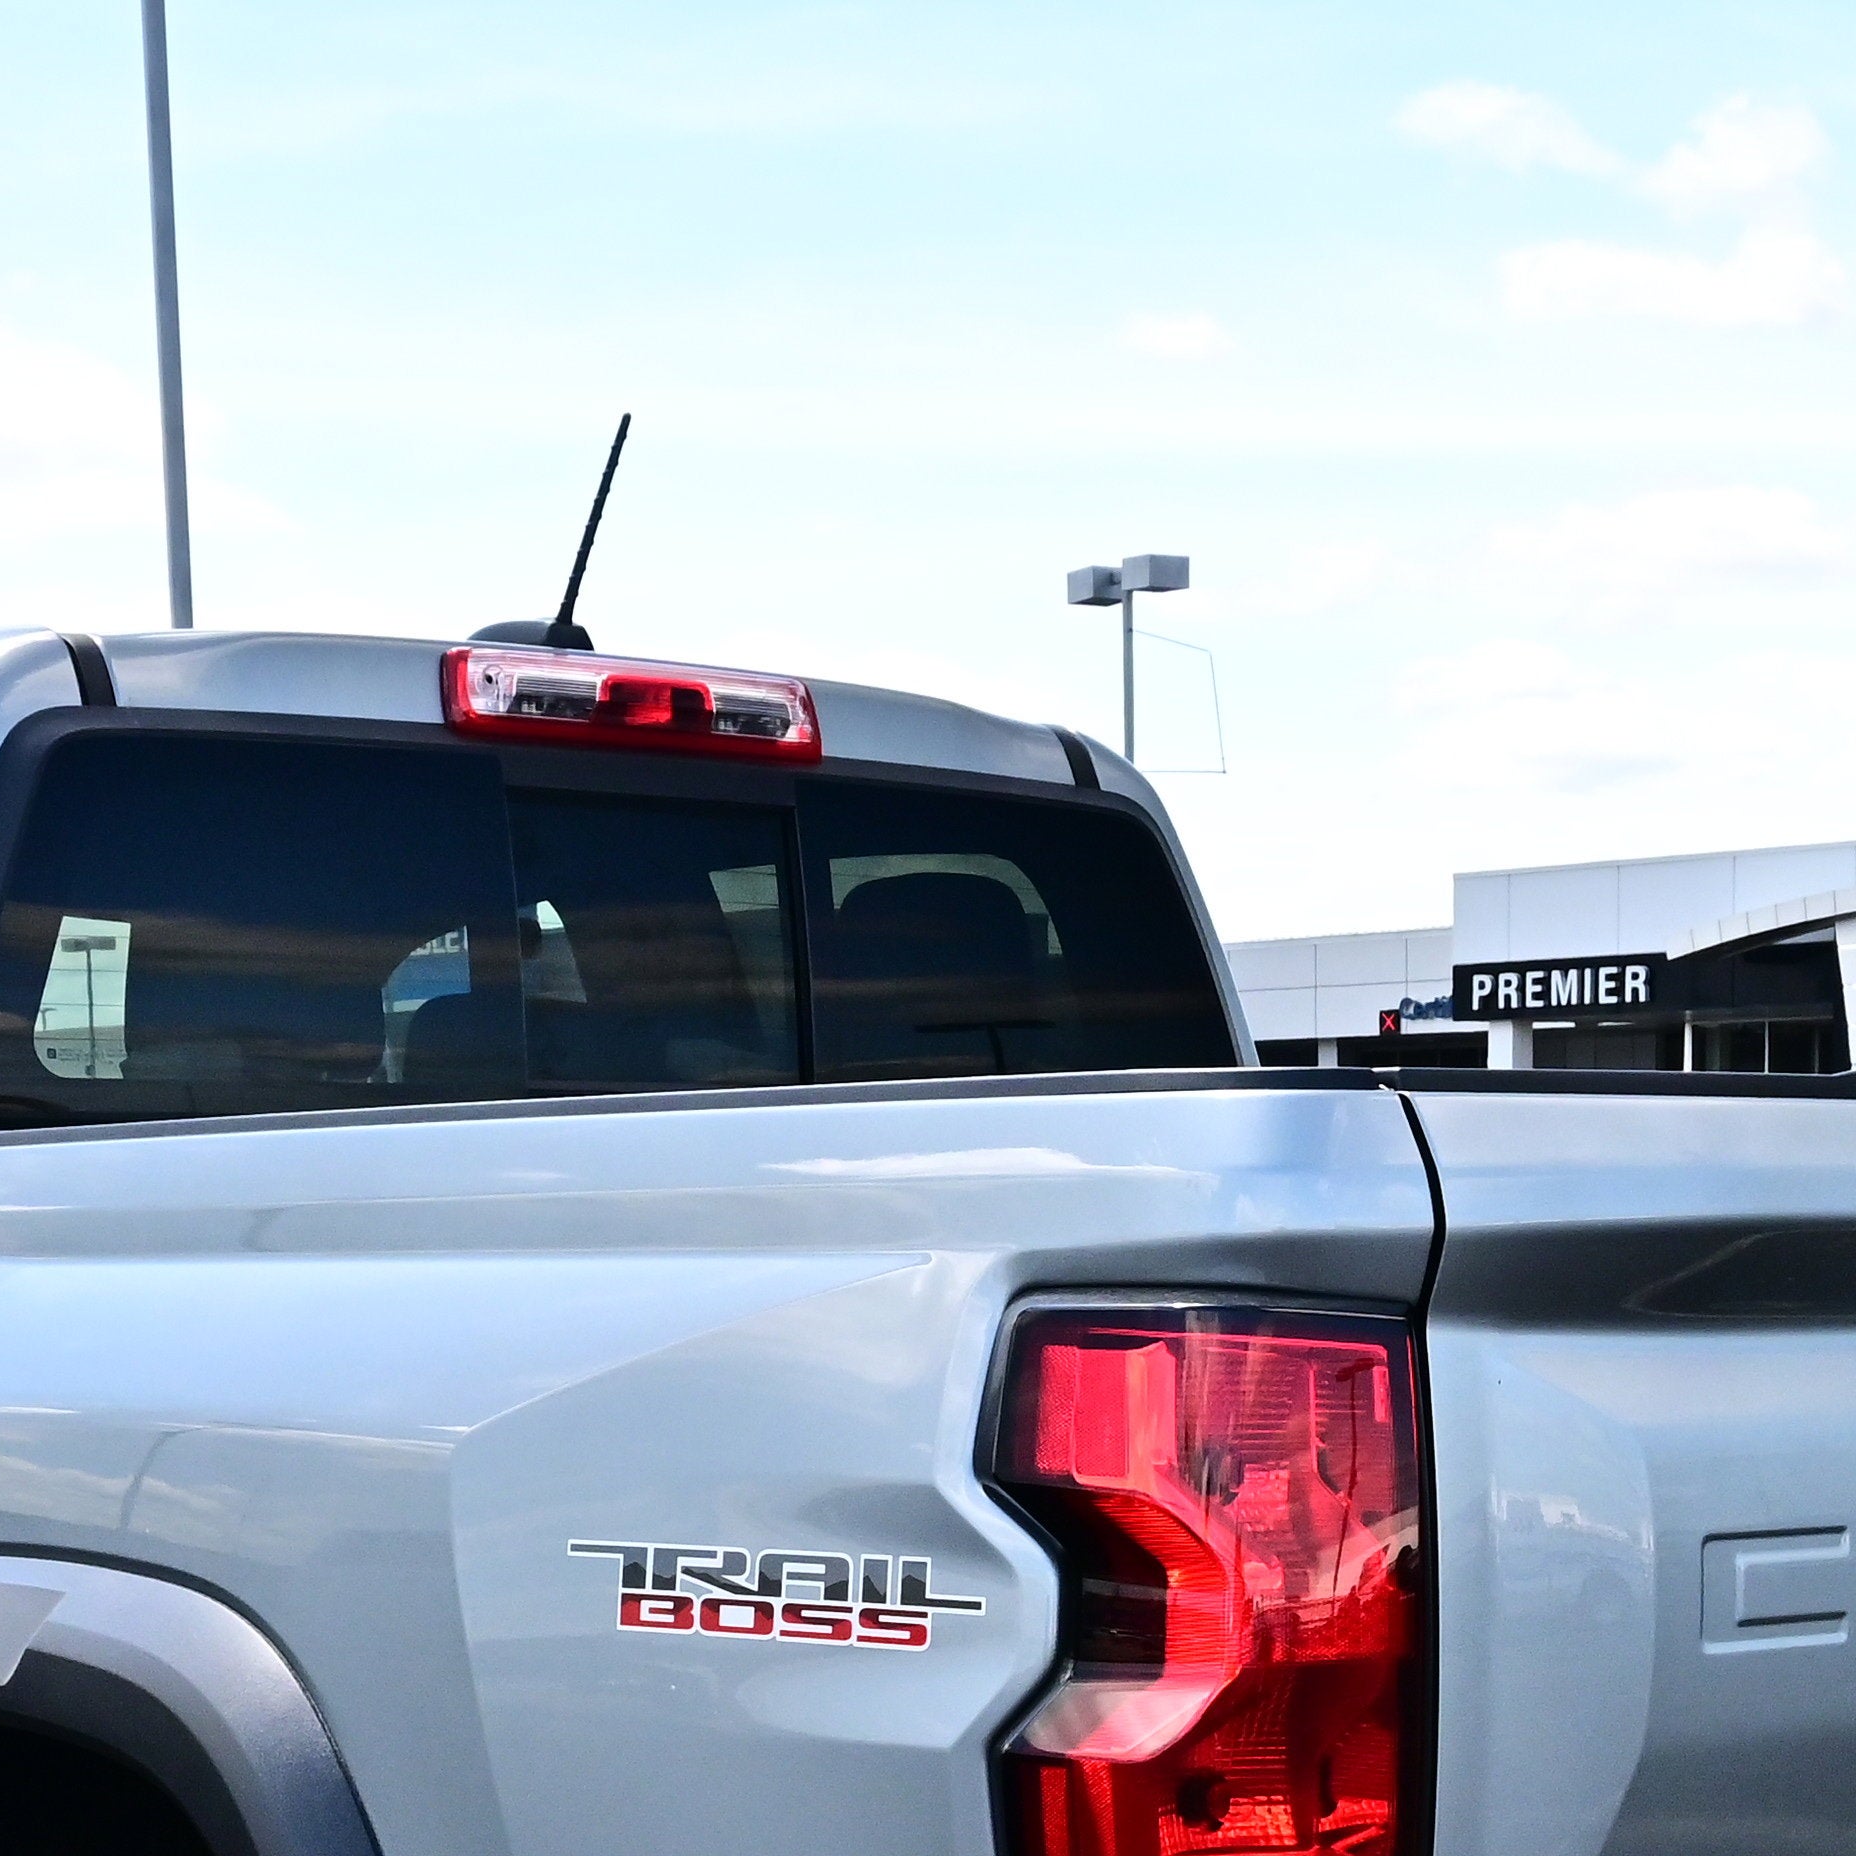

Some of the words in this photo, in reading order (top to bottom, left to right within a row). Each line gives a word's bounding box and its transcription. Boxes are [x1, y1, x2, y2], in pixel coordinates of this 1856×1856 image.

[1471, 965, 1651, 1011] PREMIER
[567, 1538, 987, 1616] TRAIL
[616, 1592, 932, 1652] BOSS
